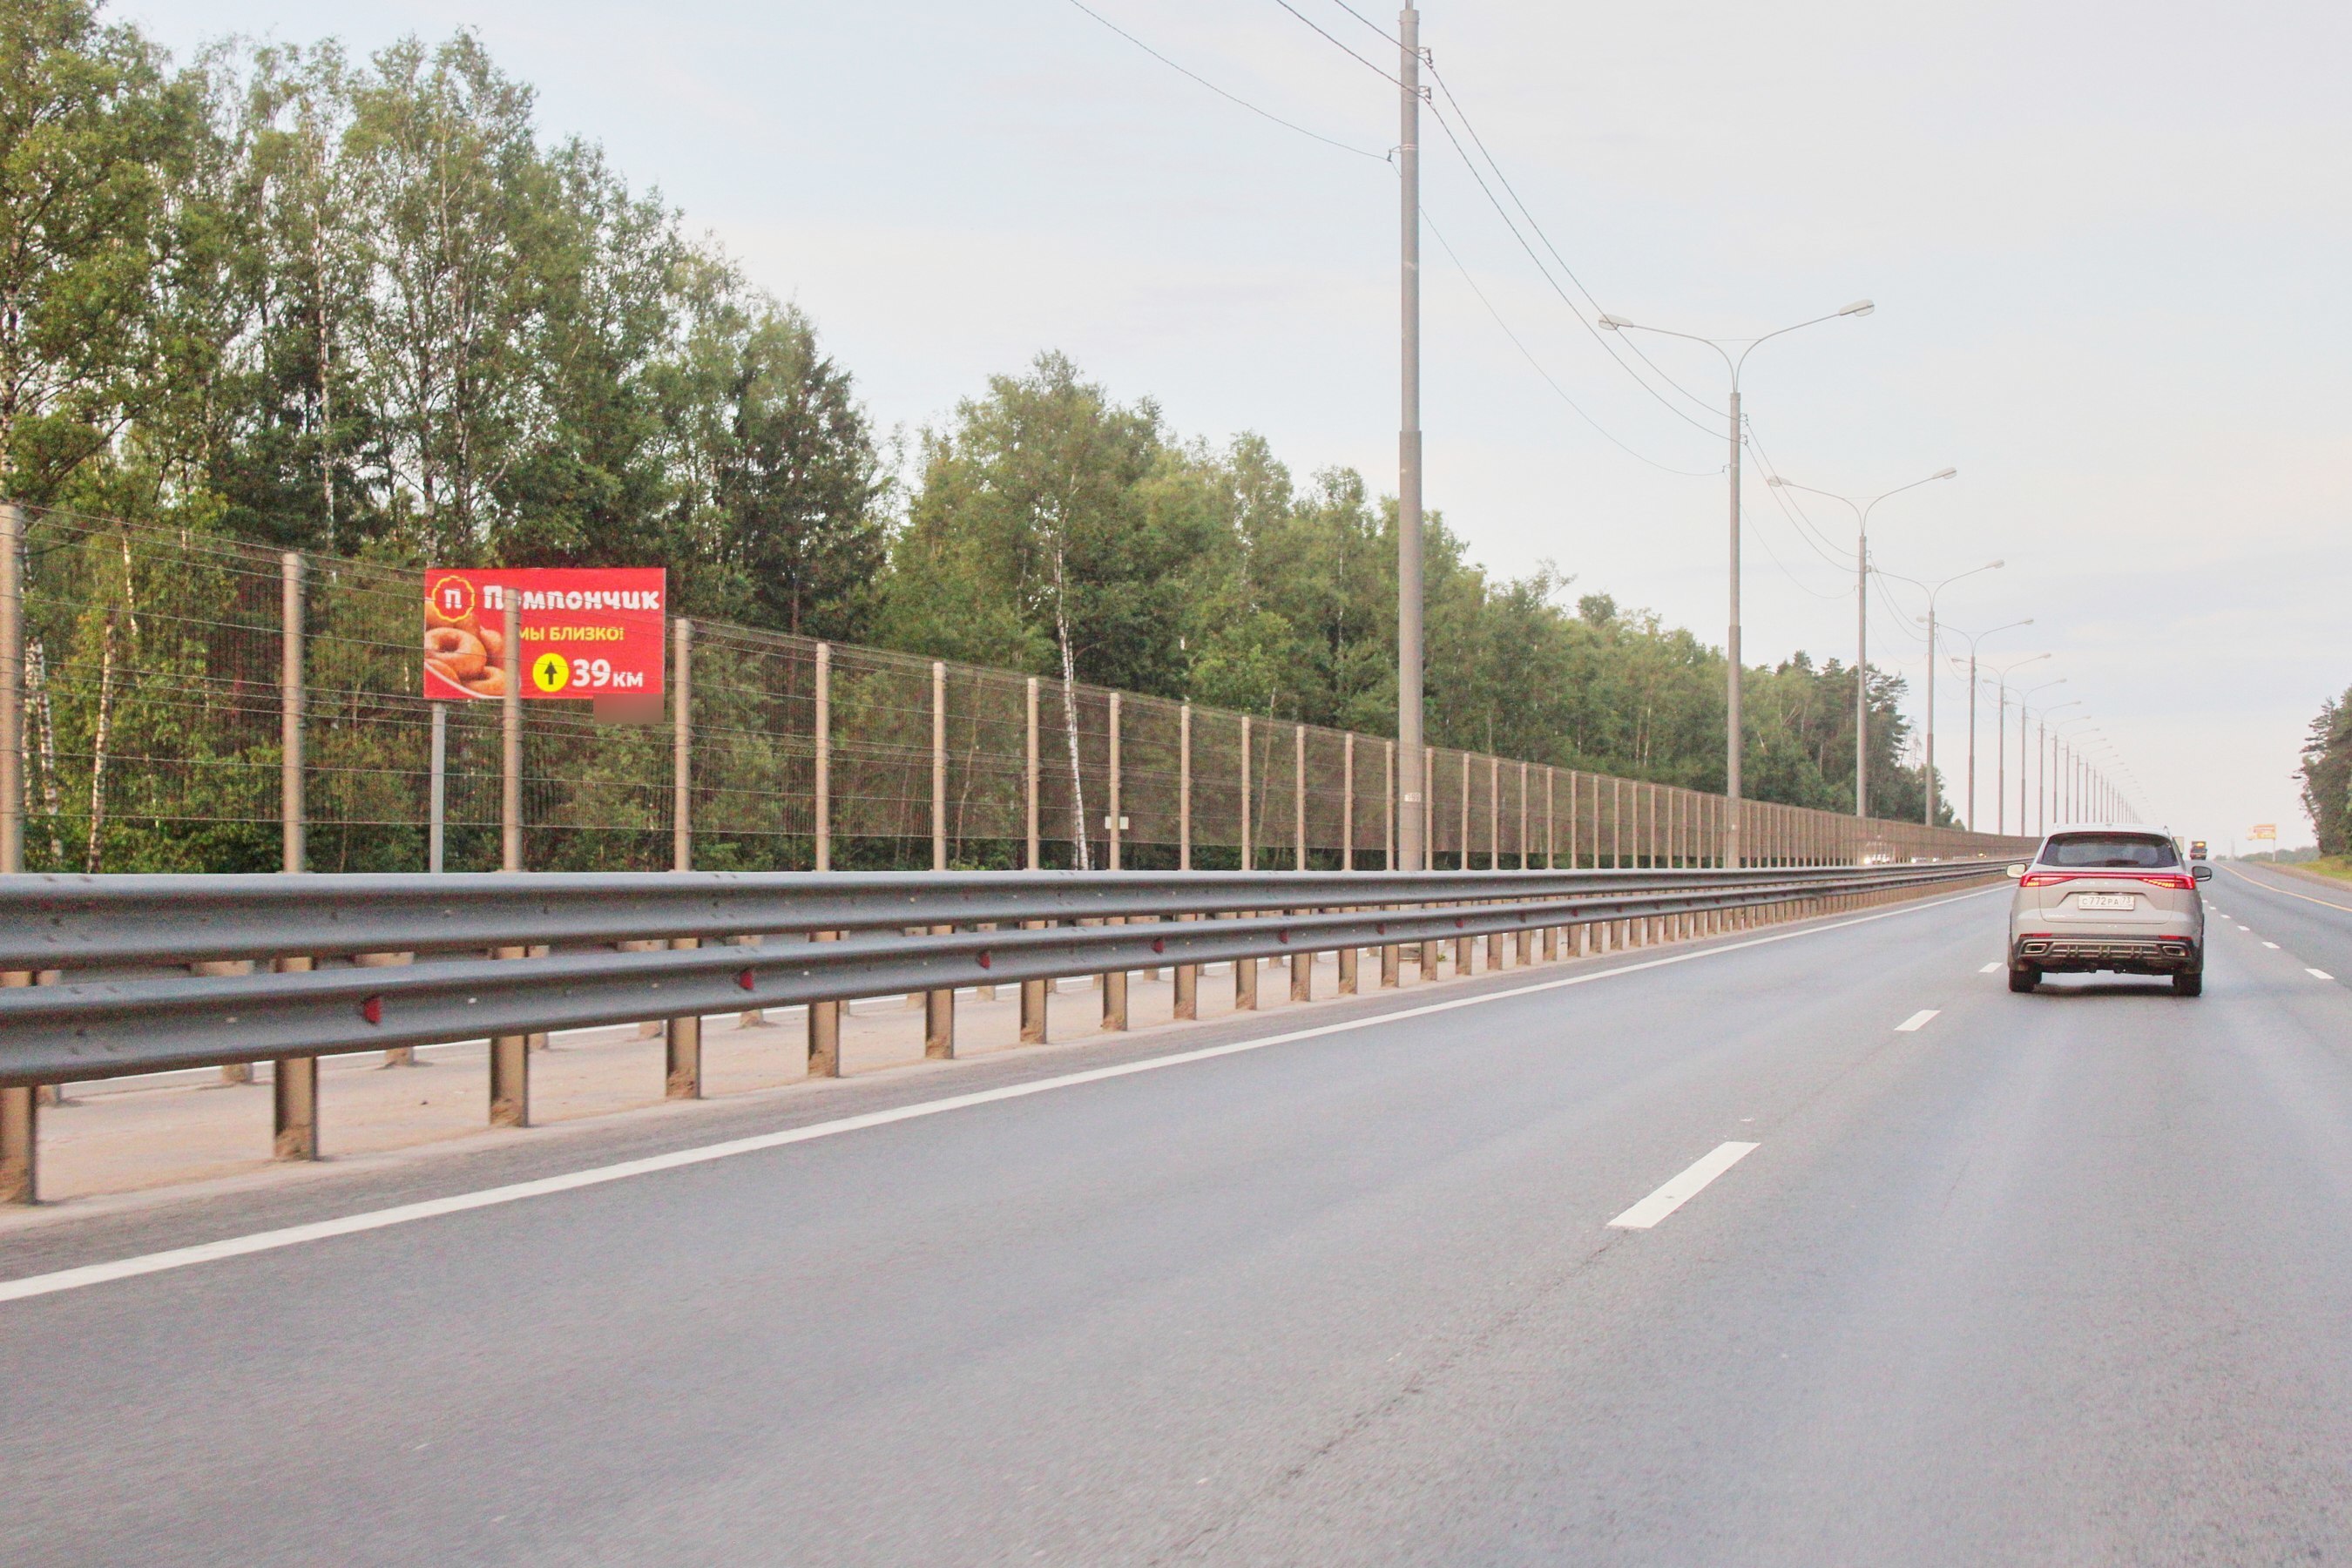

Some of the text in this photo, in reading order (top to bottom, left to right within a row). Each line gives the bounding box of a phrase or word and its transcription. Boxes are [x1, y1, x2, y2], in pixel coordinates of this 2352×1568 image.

[444, 589, 462, 608] П
[483, 585, 659, 611] Пмпончик
[550, 627, 625, 640] БЛИЗКО!
[571, 659, 611, 687] 39
